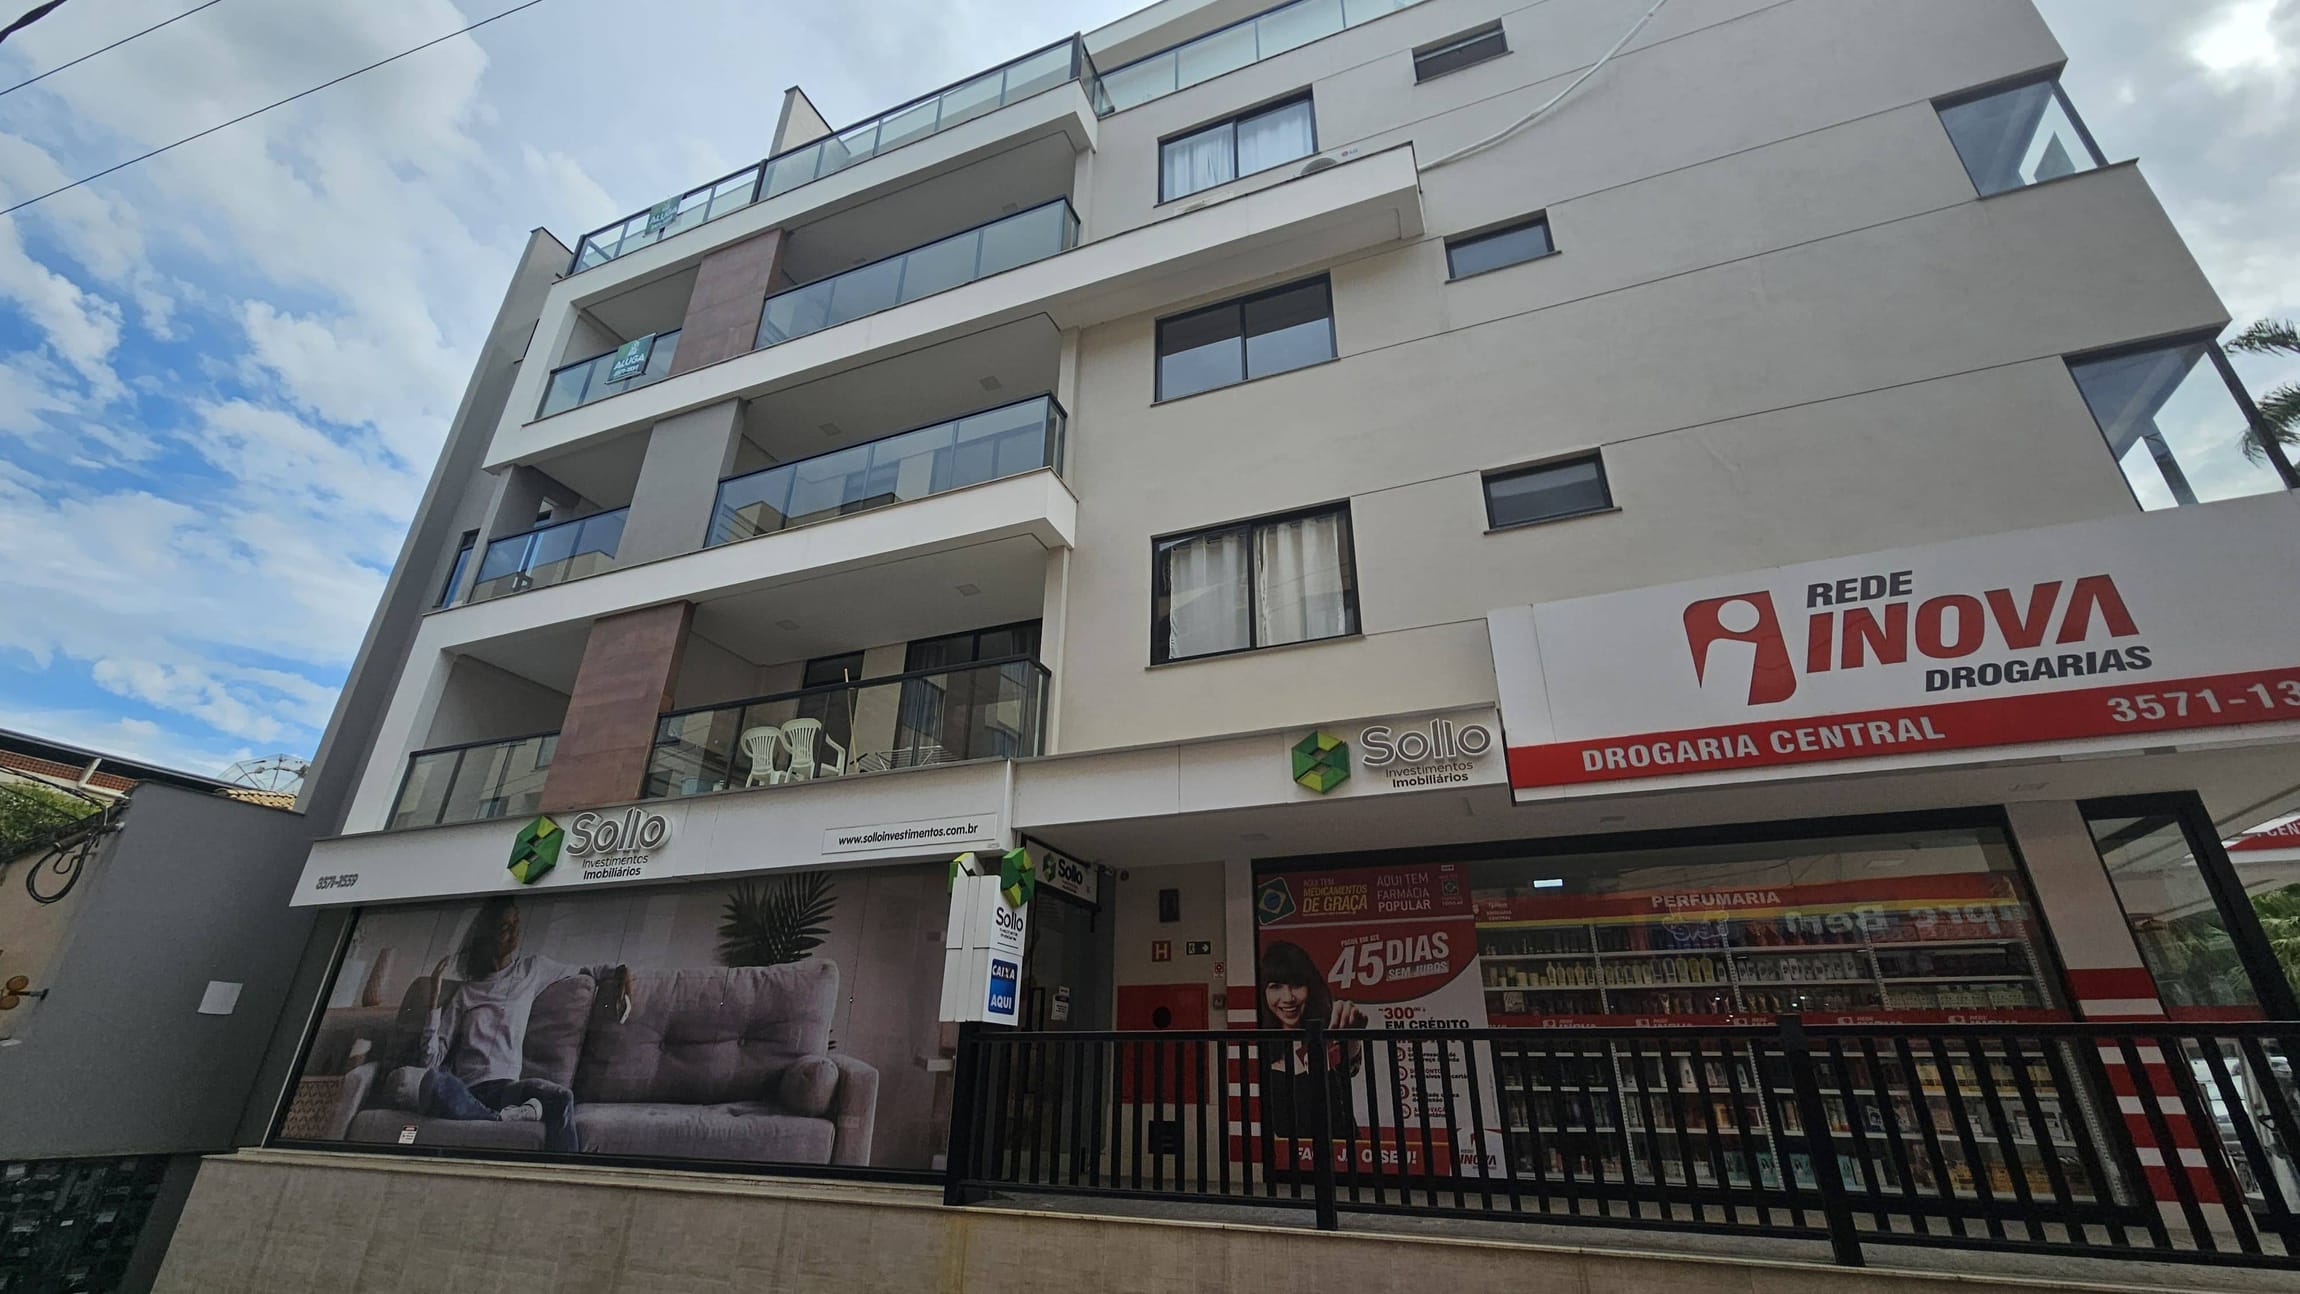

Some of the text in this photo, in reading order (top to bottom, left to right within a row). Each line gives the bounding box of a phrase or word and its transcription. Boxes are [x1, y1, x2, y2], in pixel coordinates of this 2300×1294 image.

[613, 353, 645, 370] ALUGA
[1806, 570, 1913, 608] REDE
[1806, 574, 2140, 674] INOVA
[1925, 646, 2153, 692] DROGARIAS
[1360, 718, 1491, 766] Sollo
[1582, 716, 1946, 771] DROGARIA CENTRAL
[1386, 761, 1473, 778] Investimentos
[1392, 772, 1469, 788] Imobiliários
[566, 807, 670, 856] Sollo
[838, 823, 979, 845] www.solloinvestimentos.com.br
[582, 855, 649, 868] Investimentos
[583, 866, 642, 880] Imobiliários
[1057, 858, 1083, 885] Sollo
[1377, 872, 1429, 888] AQUI TEM
[1303, 884, 1368, 897] MEDICAMENTOS
[1302, 897, 1320, 913] DE
[1378, 899, 1432, 913] POPULAR
[1651, 891, 1782, 908] PERFUMARIA
[996, 906, 1024, 932] Sollo
[1155, 943, 1168, 960] H
[1327, 931, 1449, 989] 45 DIAS
[991, 964, 1016, 979] CAIXA
[1388, 966, 1411, 979] SEM
[990, 994, 1012, 1009] AQUI
[1384, 1007, 1414, 1020] 300
[1409, 1017, 1469, 1029] CRÉDITO
